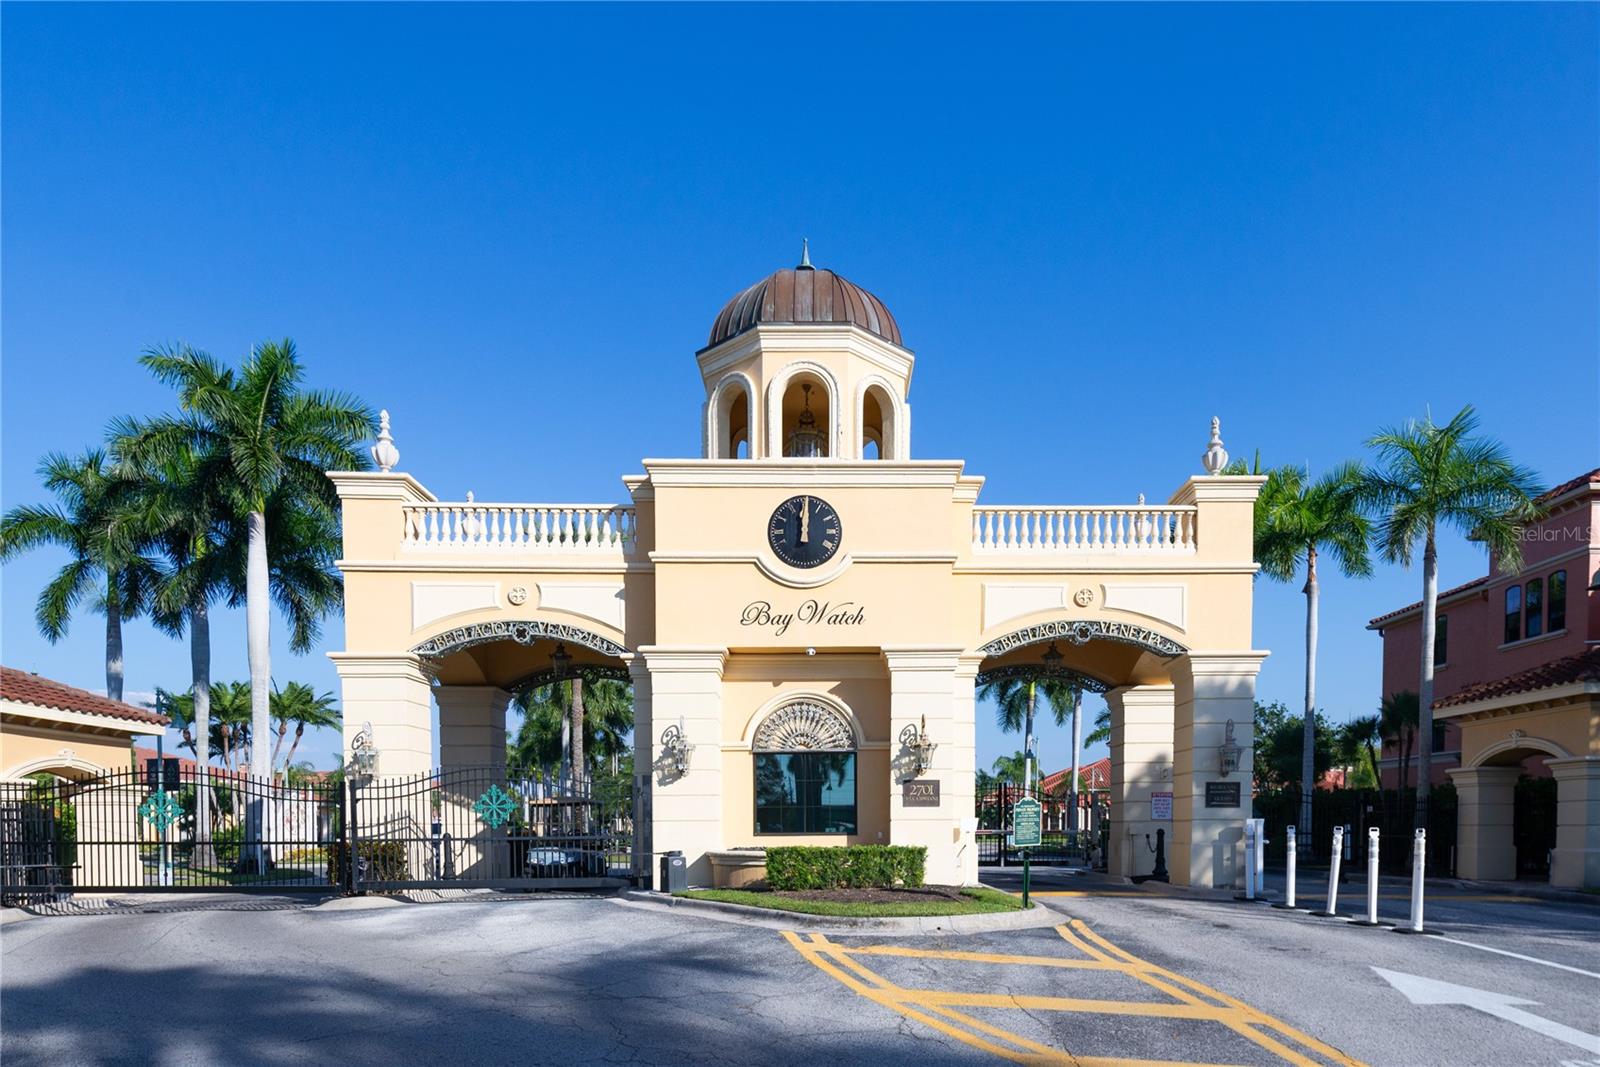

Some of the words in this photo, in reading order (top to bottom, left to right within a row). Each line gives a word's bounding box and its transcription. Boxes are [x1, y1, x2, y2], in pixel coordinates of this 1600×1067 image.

[740, 600, 794, 637] Bay
[797, 599, 865, 626] Watch
[910, 784, 935, 797] 2701
